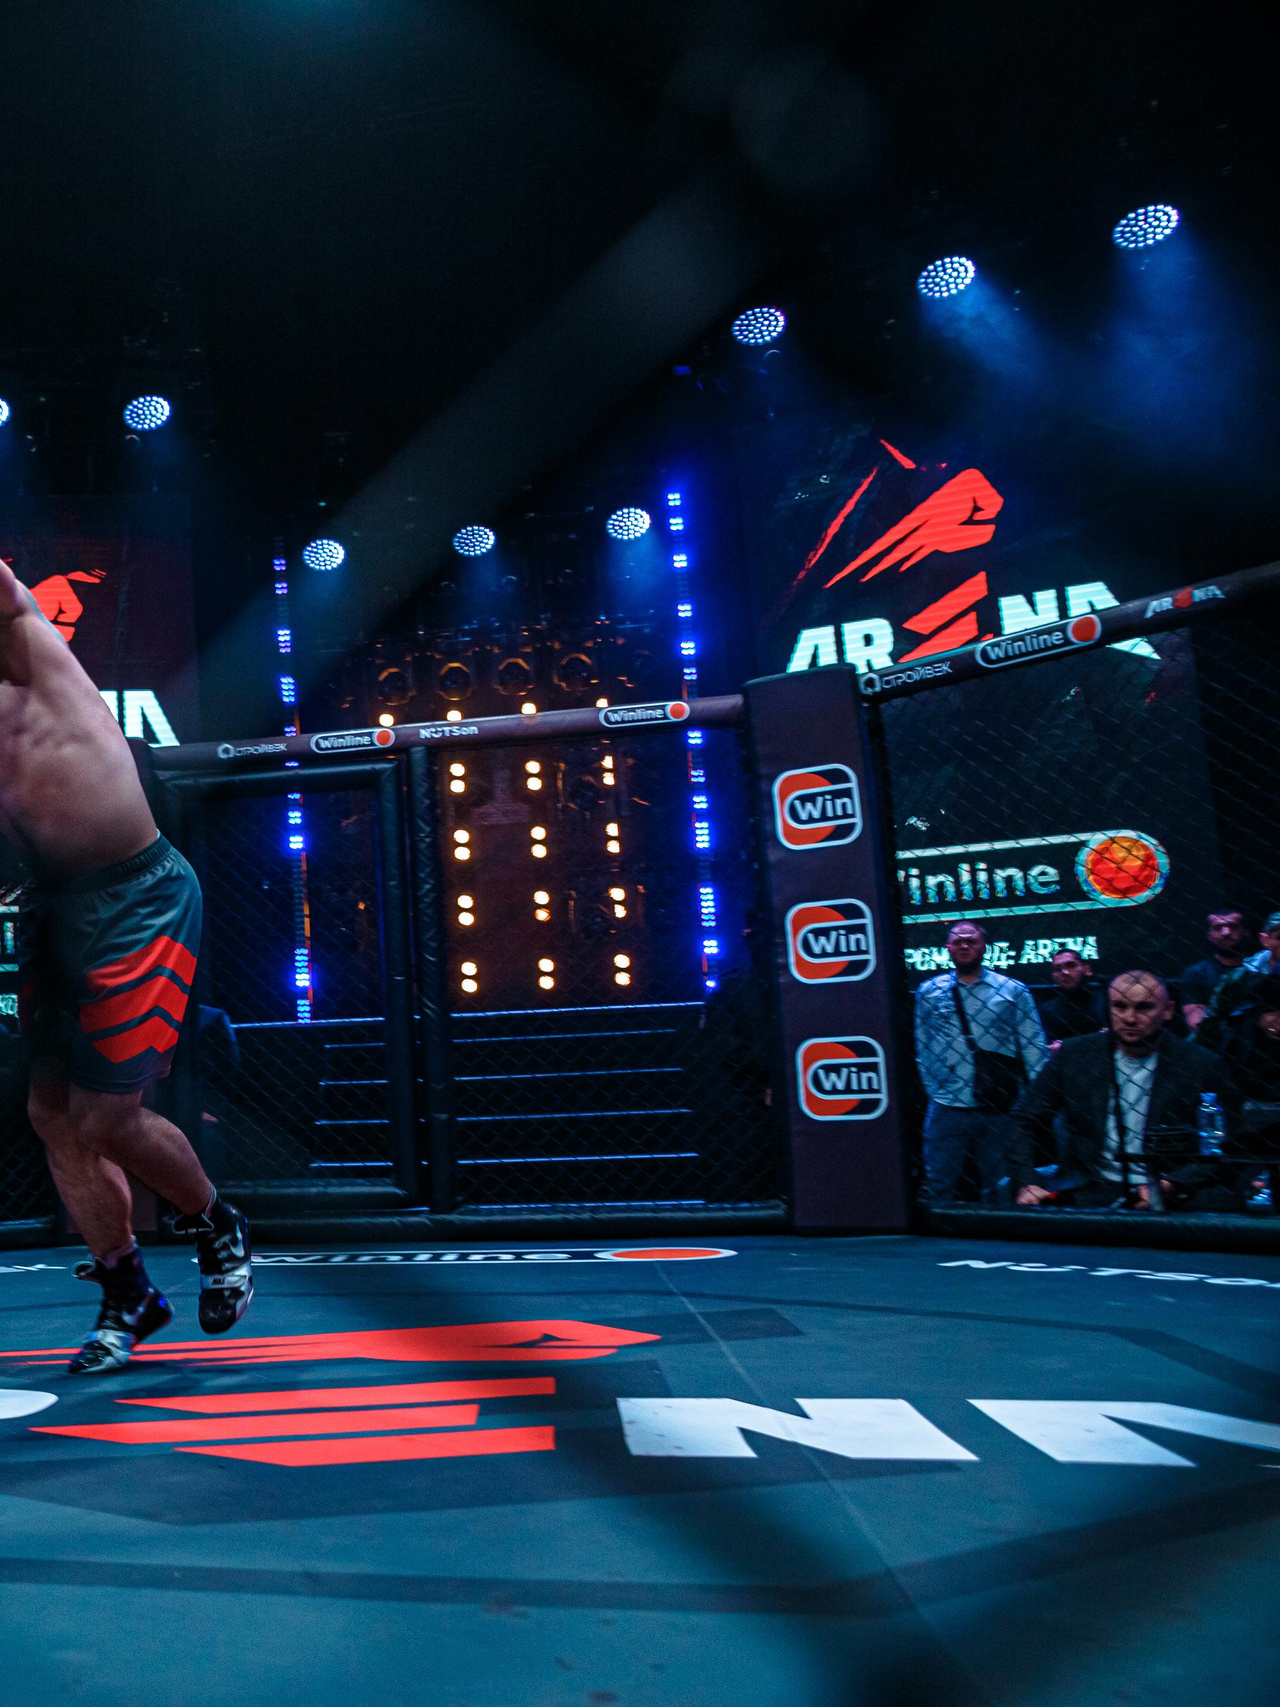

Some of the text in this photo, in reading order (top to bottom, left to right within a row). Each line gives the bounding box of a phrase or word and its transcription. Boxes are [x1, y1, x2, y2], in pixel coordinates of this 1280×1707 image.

[1144, 585, 1226, 618] ARENA
[986, 630, 1065, 660] Winline
[882, 661, 952, 688] СТРОЙВЕК
[607, 708, 664, 722] Winline
[318, 735, 371, 749] Winline
[792, 795, 853, 820] Win
[897, 861, 1061, 905] inline
[806, 929, 868, 954] Win
[817, 1067, 879, 1091] Win
